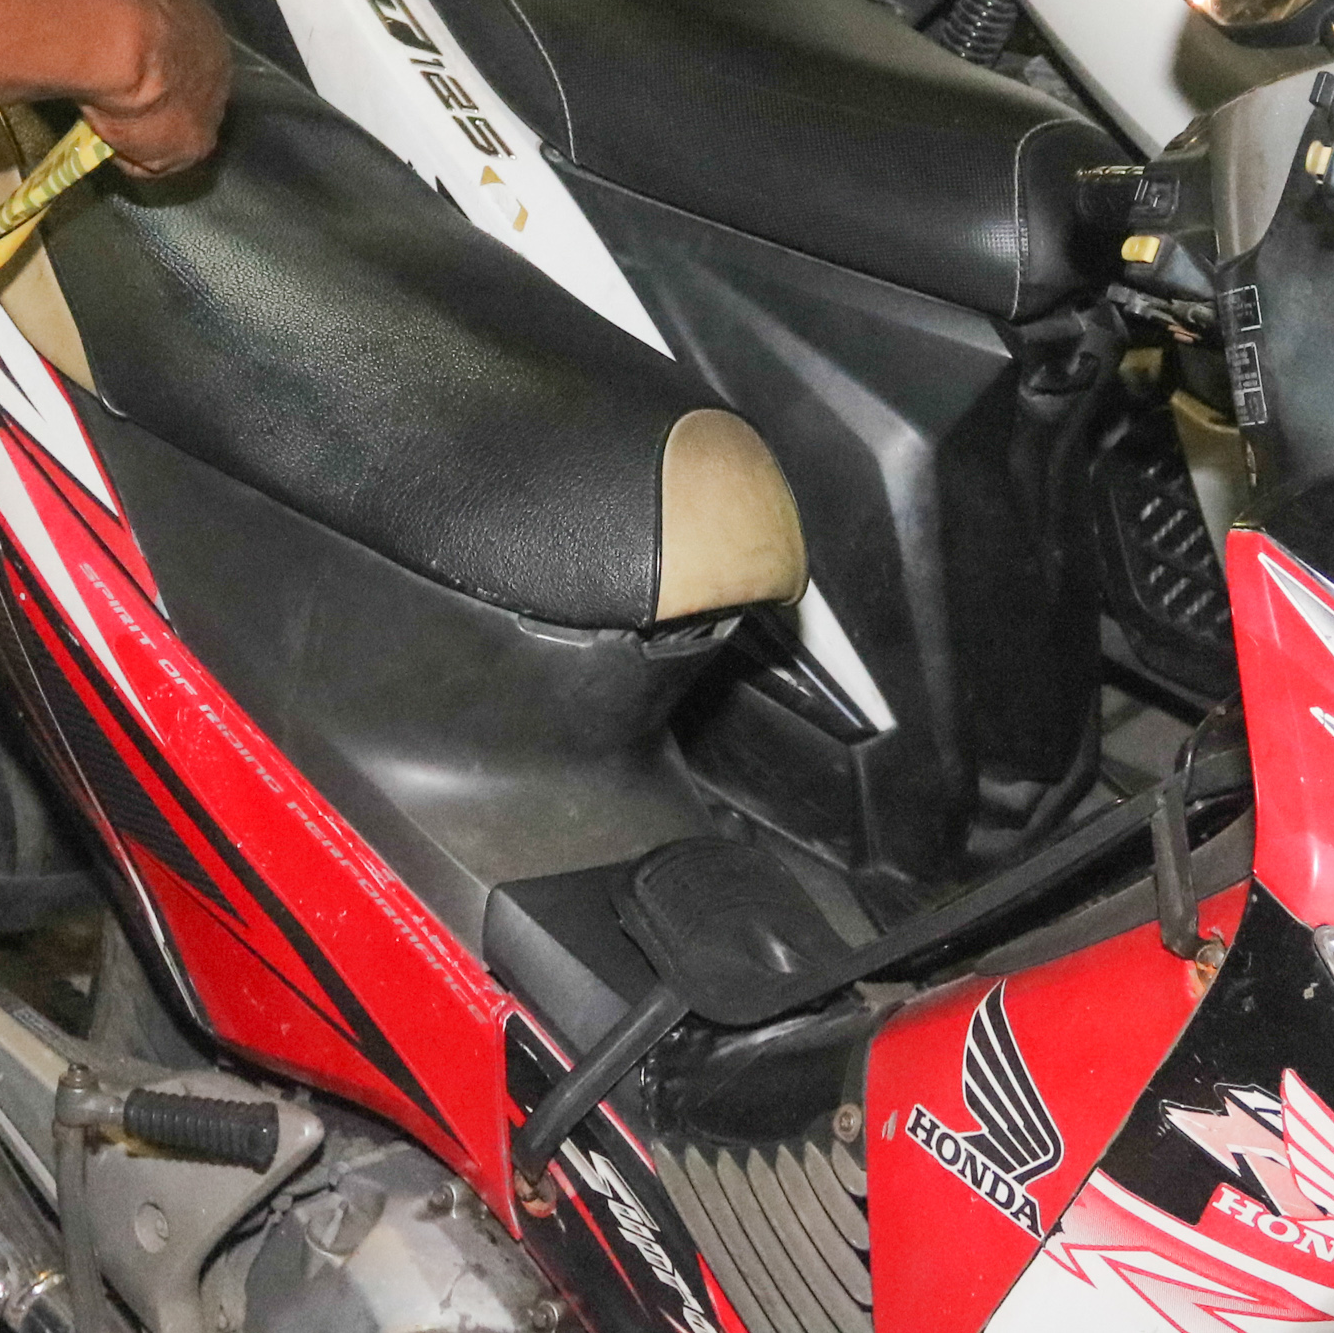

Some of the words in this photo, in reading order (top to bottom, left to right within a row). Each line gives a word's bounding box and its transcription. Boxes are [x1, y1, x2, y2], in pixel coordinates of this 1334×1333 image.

[78, 562, 157, 650] SPIRIT
[158, 658, 198, 696] OF
[907, 1106, 1043, 1239] HONDA
